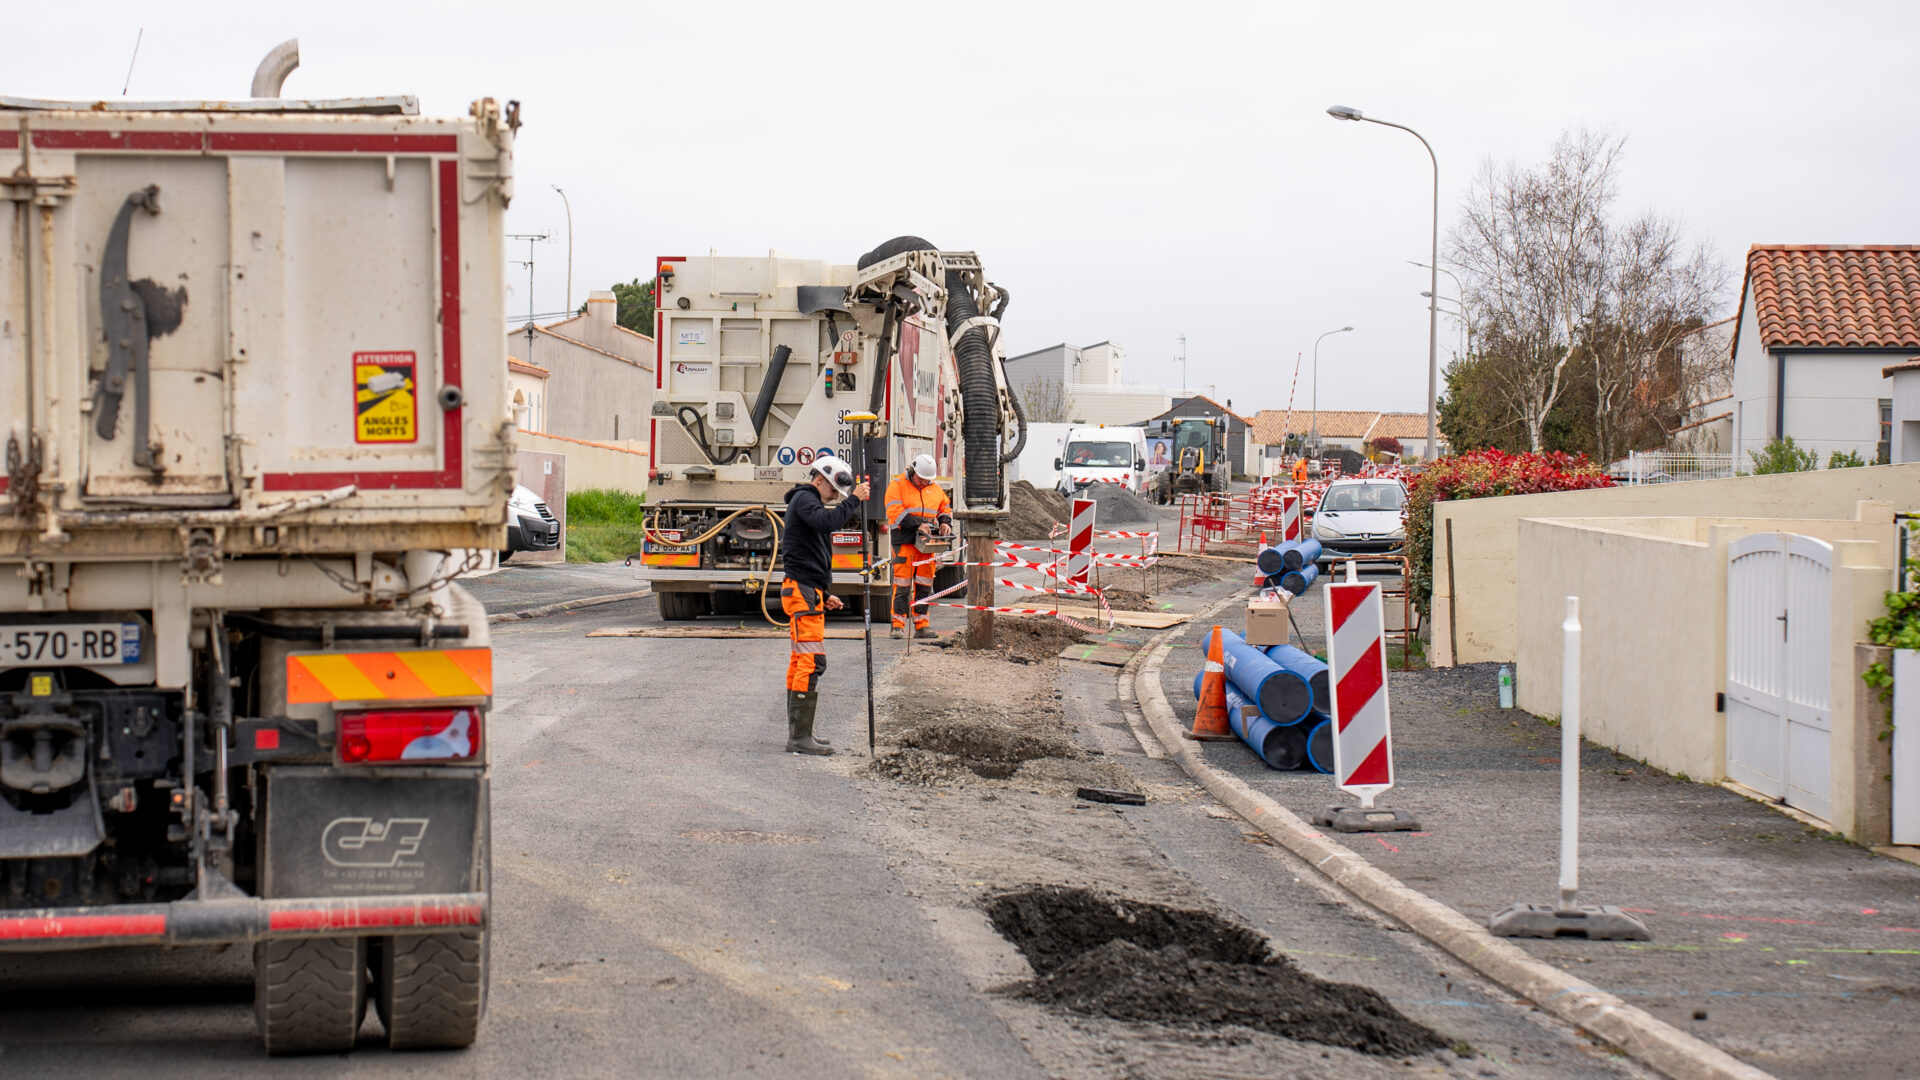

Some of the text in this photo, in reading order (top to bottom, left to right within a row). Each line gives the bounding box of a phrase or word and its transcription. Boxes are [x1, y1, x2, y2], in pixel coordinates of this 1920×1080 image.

[356, 354, 412, 363] ATTENTION
[681, 365, 708, 373] BONNAMY
[364, 416, 408, 425] ANGLES
[366, 427, 406, 435] MORTS
[838, 429, 851, 444] 80
[838, 448, 851, 463] 60
[0, 630, 117, 660] -570-RB
[123, 643, 138, 657] 85
